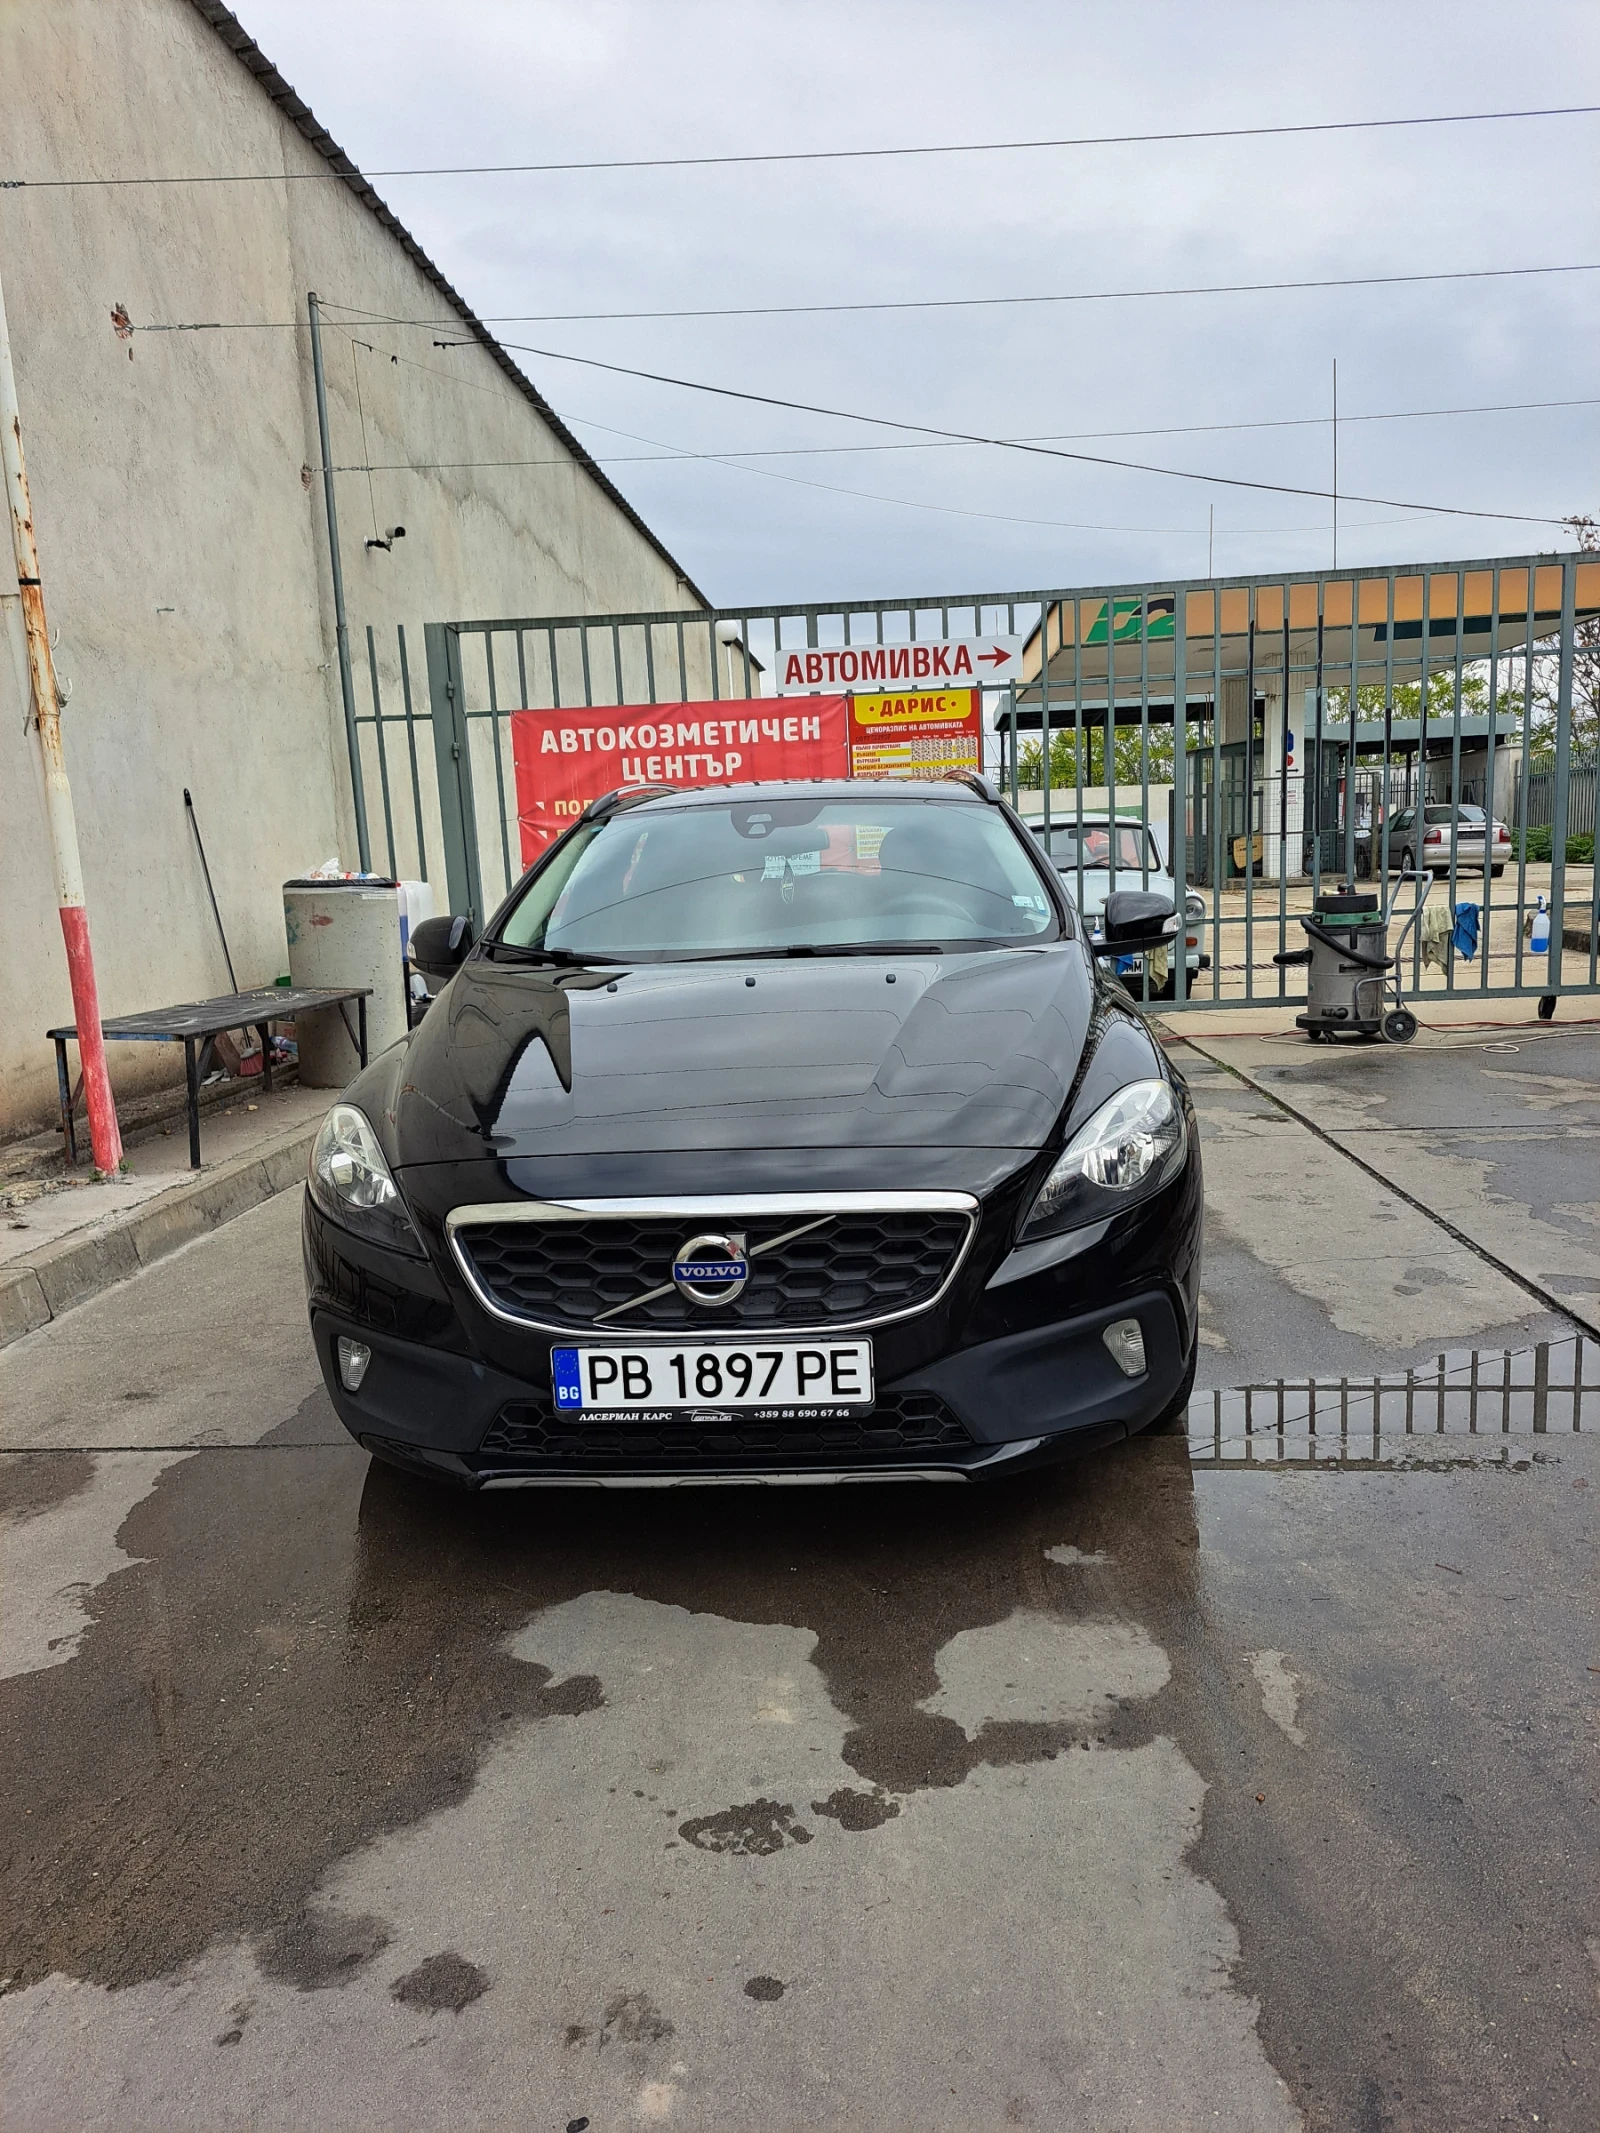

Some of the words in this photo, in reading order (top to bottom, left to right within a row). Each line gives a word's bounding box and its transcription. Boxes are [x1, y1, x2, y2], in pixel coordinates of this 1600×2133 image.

[785, 645, 973, 685] АВТОМИВКА
[880, 697, 947, 717] ДАРИС
[541, 716, 820, 754] АВТОКОЗМЕТИЧЕН
[866, 725, 907, 734] ЦЕНОРАЗПИС
[919, 721, 963, 731] АВТОМИВКАТА
[622, 752, 742, 782] ЦЕНТЪР
[678, 1266, 742, 1277] VOLVO
[588, 1355, 652, 1400] PB
[670, 1351, 783, 1399] 1897
[796, 1349, 861, 1395] PE
[559, 1386, 579, 1399] BG
[579, 1413, 639, 1421] ЛАСЕРМАН
[642, 1412, 672, 1420] КАРС
[754, 1410, 778, 1418] +359
[820, 1409, 834, 1417] 67
[836, 1409, 850, 1417] 66
